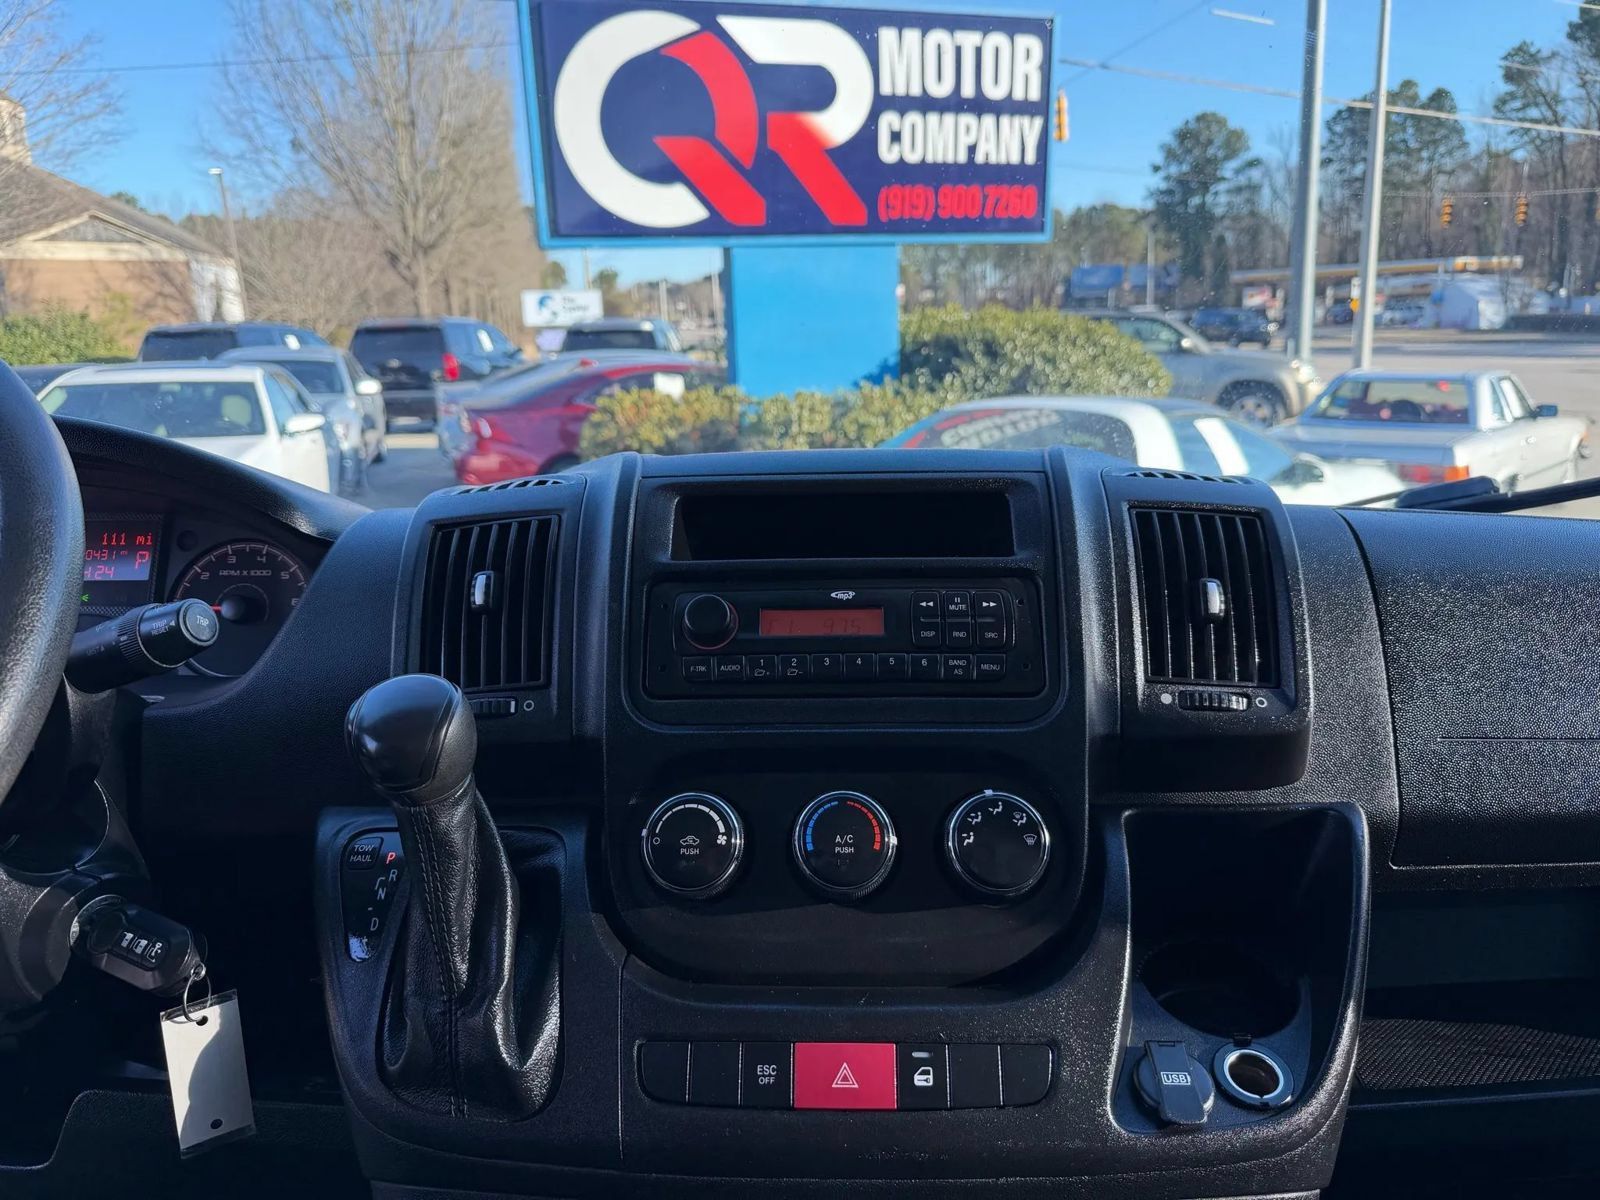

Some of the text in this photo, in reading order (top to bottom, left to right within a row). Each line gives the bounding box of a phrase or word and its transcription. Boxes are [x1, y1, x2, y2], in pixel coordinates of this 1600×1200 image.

[877, 26, 1044, 102] MOTOR
[554, 10, 874, 228] QR
[877, 110, 1044, 166] COMPANY
[877, 184, 936, 222] (919)
[937, 184, 983, 219] 900
[102, 532, 153, 546] 111 mi
[135, 551, 150, 569] P
[227, 556, 237, 564] 3
[200, 572, 210, 580] 2
[920, 630, 936, 638] DISP
[952, 630, 967, 638] RND
[984, 631, 999, 639] SRC
[759, 659, 764, 667] 1
[791, 657, 798, 667] 2
[823, 657, 831, 666] 3
[855, 656, 862, 665] 4
[889, 657, 895, 666] 5
[921, 658, 928, 667] 6
[948, 658, 967, 666] BAND
[720, 664, 741, 672] AUDIO
[980, 663, 1000, 671] MENU
[953, 668, 963, 676] AS
[834, 834, 854, 844] A/C
[353, 844, 375, 852] TOW
[680, 847, 700, 855] PUSH
[834, 846, 854, 854] PUSH
[386, 852, 397, 864] P
[388, 869, 398, 882] R
[377, 887, 387, 900] N
[370, 917, 379, 931] D
[757, 1065, 777, 1075] ESC
[758, 1076, 776, 1085] OFF
[1163, 1074, 1187, 1084] USB
